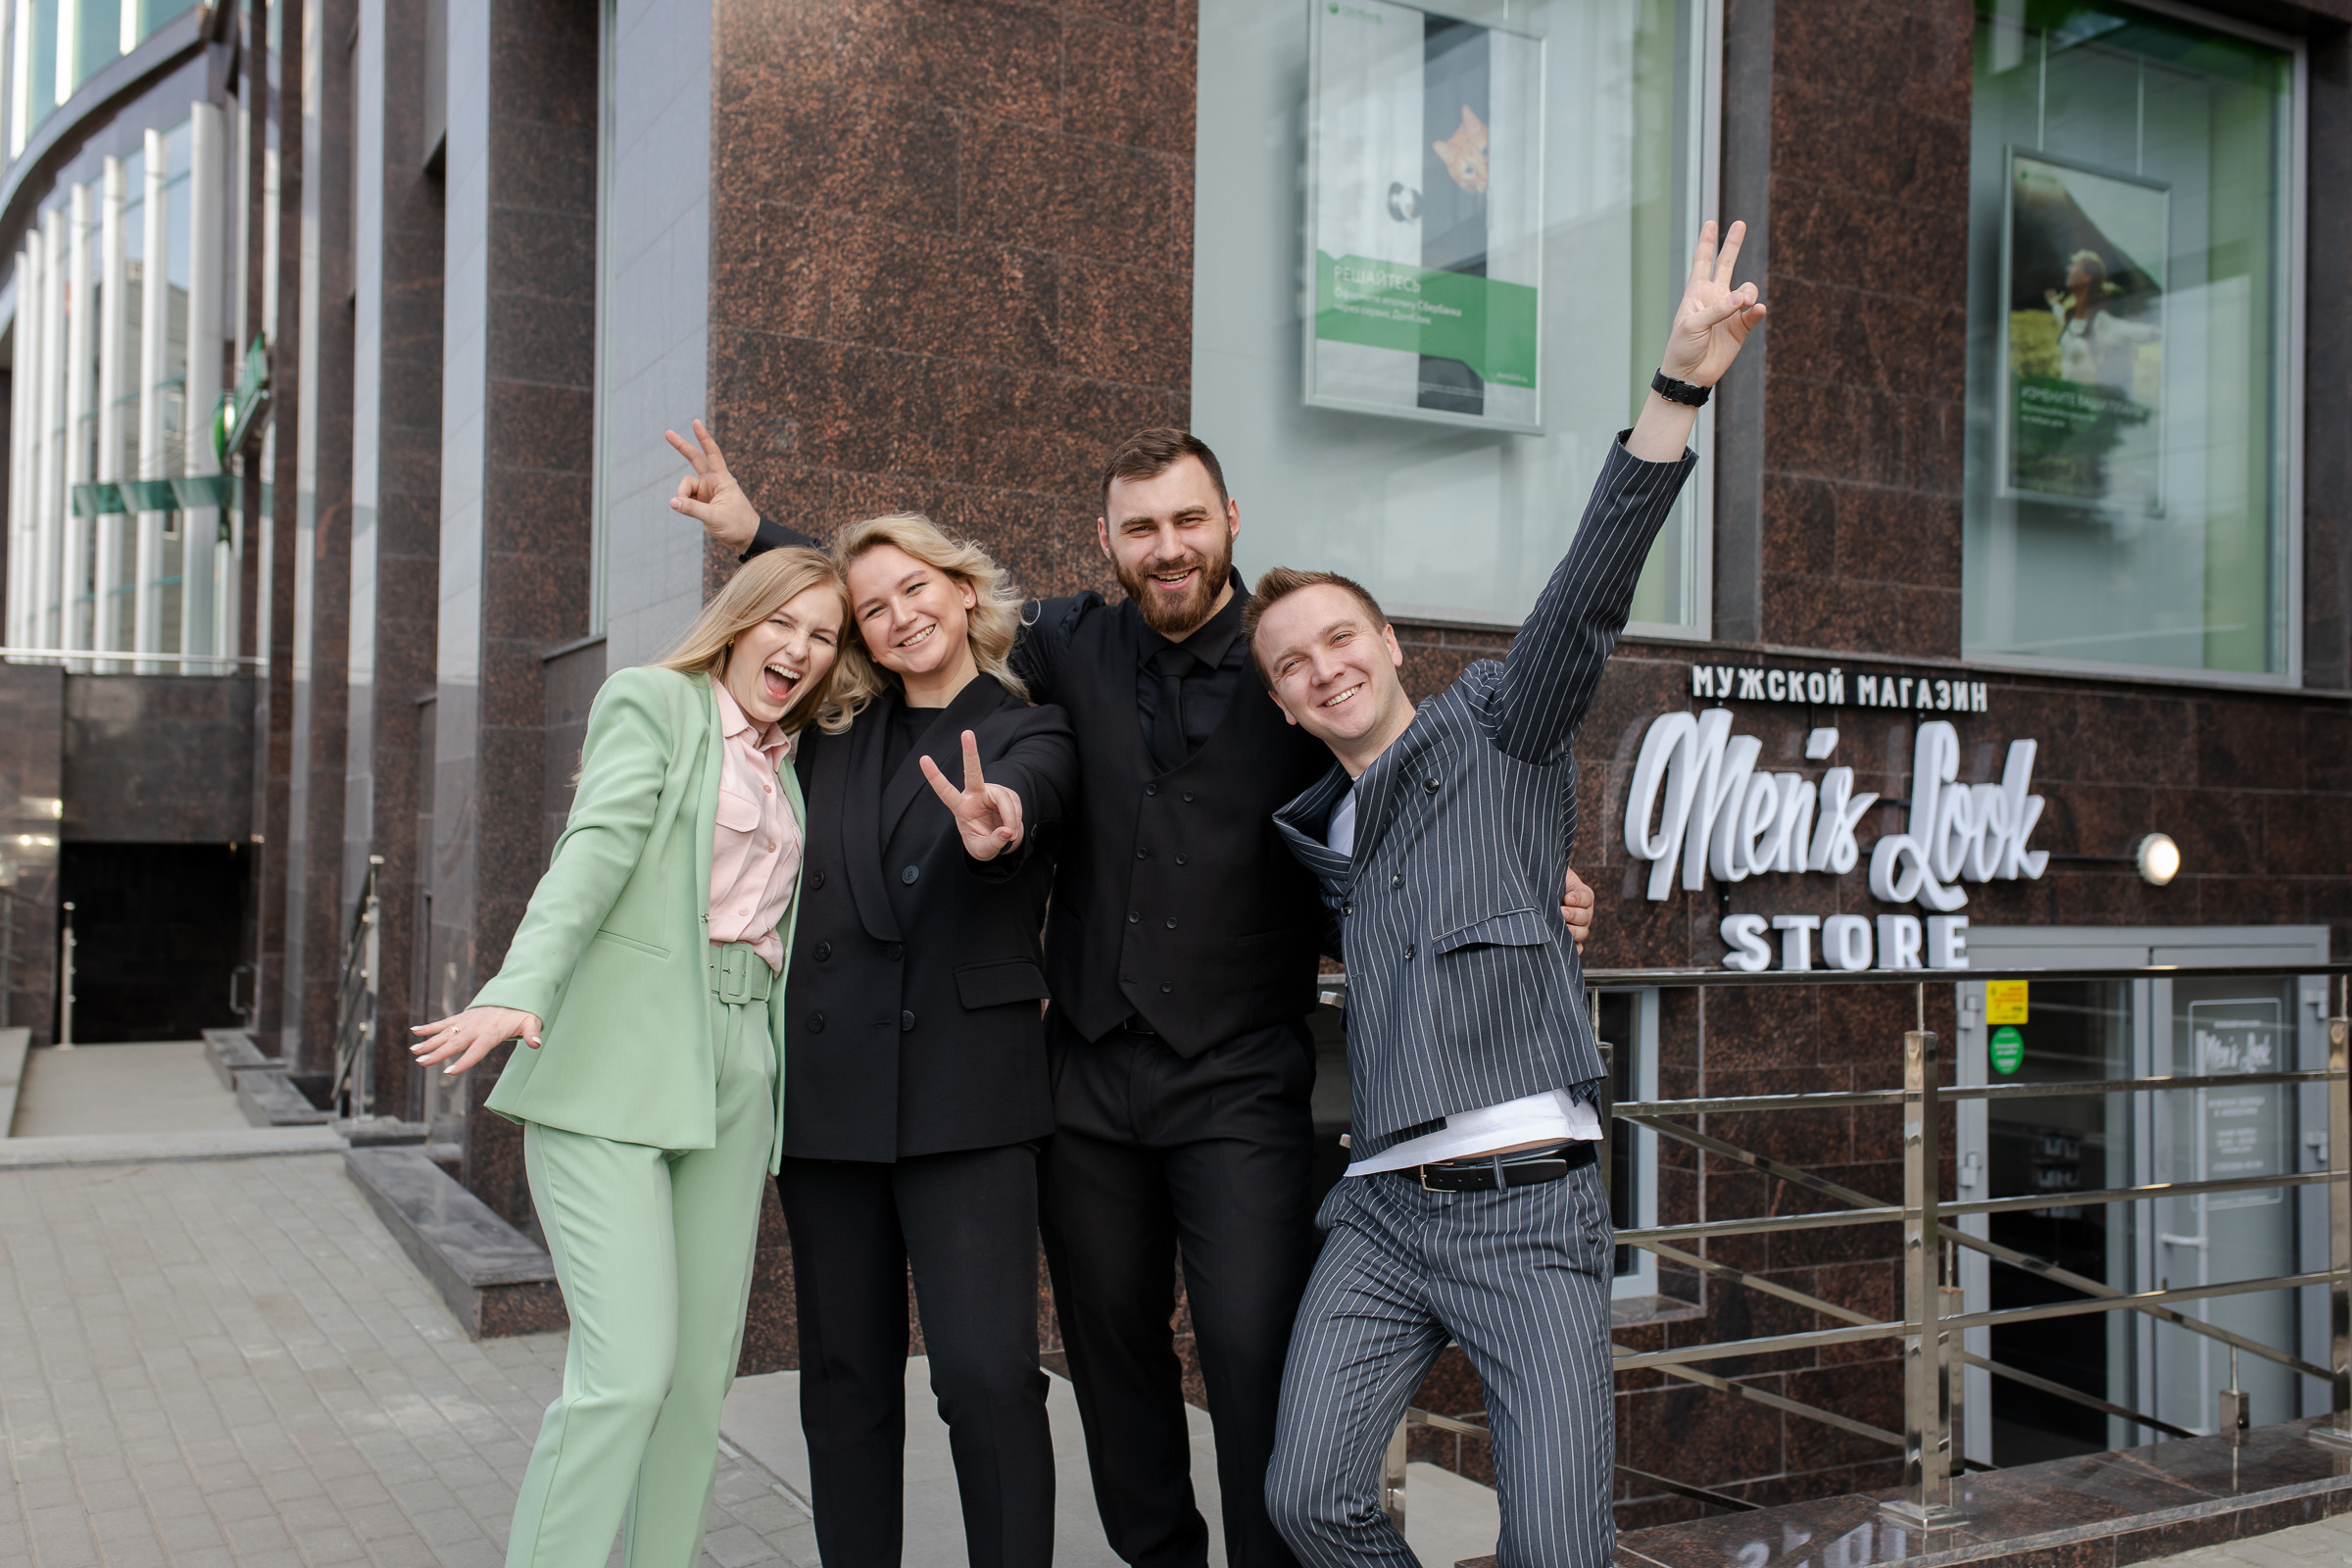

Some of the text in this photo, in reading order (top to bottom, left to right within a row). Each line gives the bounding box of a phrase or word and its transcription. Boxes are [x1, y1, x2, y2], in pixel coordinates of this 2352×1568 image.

[1334, 265, 1421, 293] РЕШАЙТЕСЬ
[1692, 664, 1988, 712] МУЖСКОЙ МАГАЗИН
[1624, 708, 2050, 911] Men's Look
[1720, 913, 1970, 971] STORE
